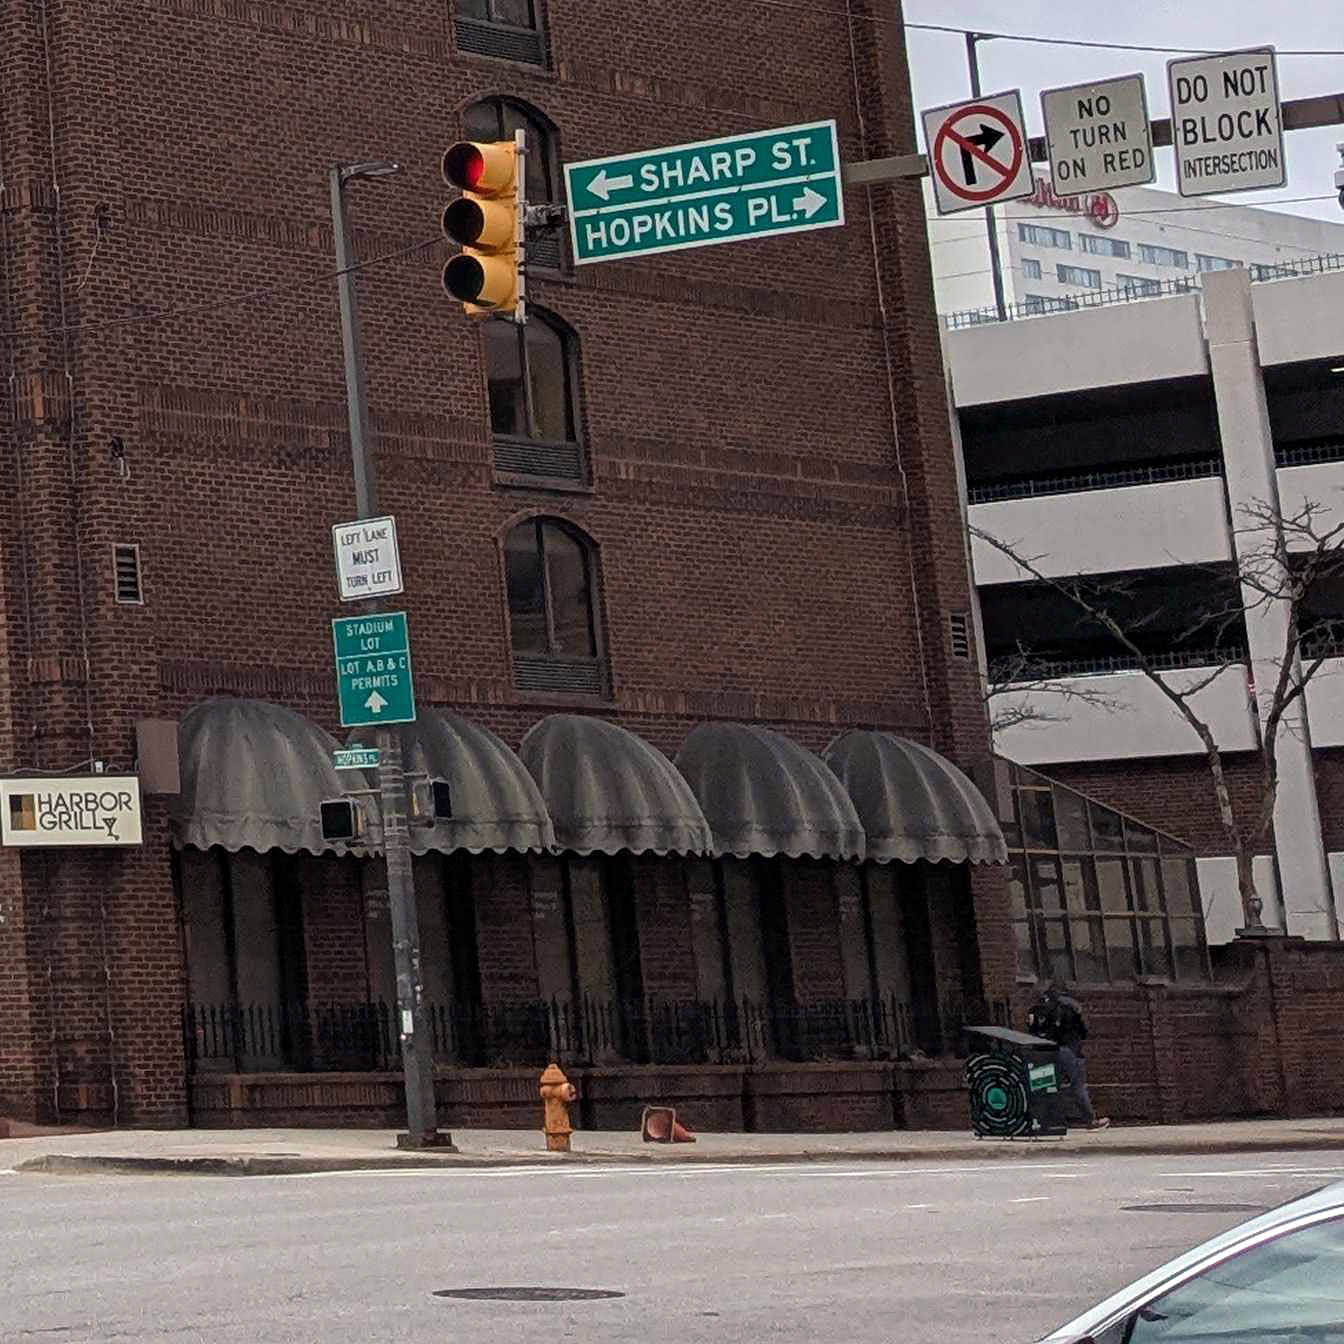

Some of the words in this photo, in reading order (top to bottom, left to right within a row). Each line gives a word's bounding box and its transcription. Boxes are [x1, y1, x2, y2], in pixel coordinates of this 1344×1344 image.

[1176, 75, 1208, 105] DO
[1223, 66, 1268, 99] NOT
[1077, 95, 1110, 120] NO
[1070, 122, 1128, 149] TURN
[1183, 108, 1272, 145] BLOCK
[639, 147, 757, 192] SHARP
[771, 137, 816, 171] ST.
[1057, 159, 1086, 180] ON
[1104, 148, 1145, 174] RED
[1184, 148, 1278, 179] INTERSECTION
[585, 203, 734, 250] HOPKINS
[747, 195, 798, 227] PL.
[340, 532, 360, 546] LEFT
[365, 528, 388, 542] LANE
[353, 548, 379, 565] MUST
[346, 575, 369, 588] TURN
[372, 571, 392, 584] LEFT
[345, 620, 394, 636] STADIUM
[360, 637, 380, 651] LOT
[341, 661, 360, 675] LOT
[398, 657, 406, 669] C
[351, 675, 399, 690] PERMITS
[37, 791, 133, 813] HARBOR
